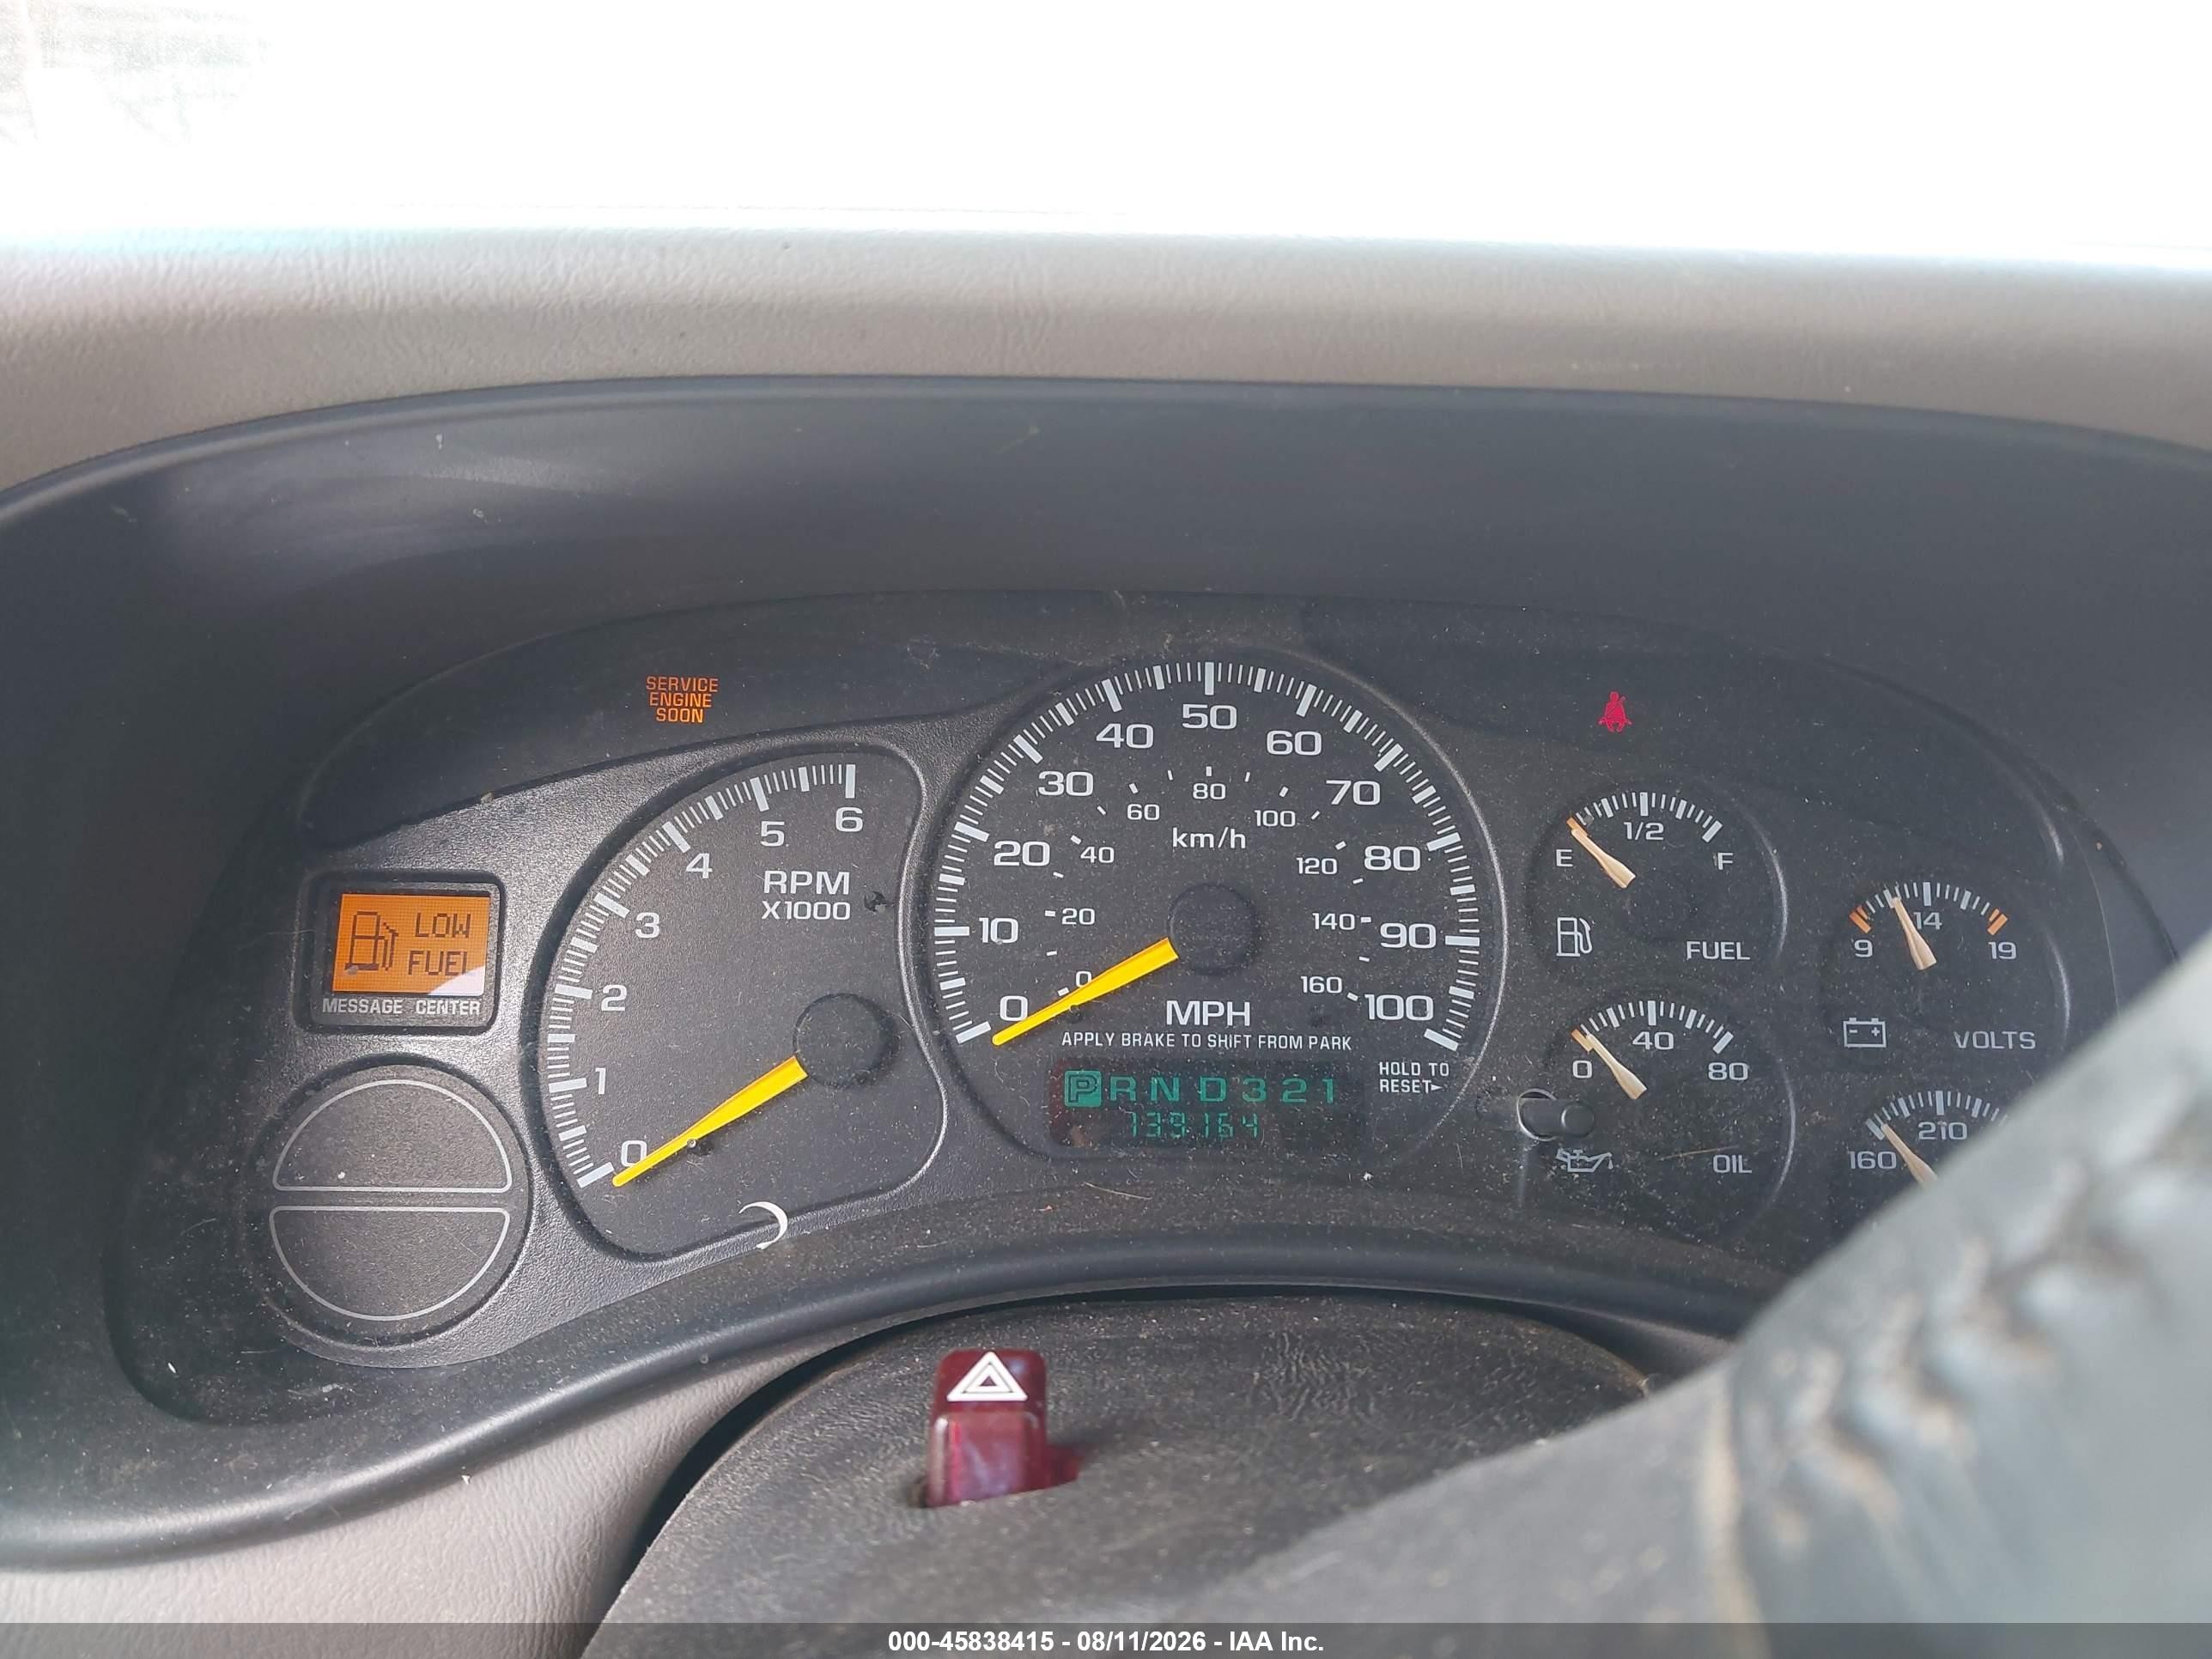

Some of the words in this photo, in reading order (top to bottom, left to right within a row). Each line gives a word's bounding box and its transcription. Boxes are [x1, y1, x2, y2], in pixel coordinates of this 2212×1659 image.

[647, 677, 718, 693] SERVICE
[649, 692, 713, 708] ENGINE
[656, 708, 703, 723] SOON
[1182, 704, 1237, 729] 50
[1097, 724, 1154, 748] 40
[1267, 732, 1322, 757] 60
[1037, 772, 1093, 797] 30
[1192, 783, 1225, 799] 80
[1326, 781, 1380, 805] 70
[835, 807, 863, 832] 6
[1127, 805, 1160, 821] 60
[1254, 811, 1297, 828] 100
[761, 821, 785, 848] 5
[1172, 829, 1247, 849] km/h
[1624, 822, 1665, 841] 1/2
[994, 842, 1051, 866] 20
[1080, 847, 1115, 864] 40
[1364, 847, 1420, 872] 80
[1557, 850, 1572, 868] E
[1717, 853, 1733, 871] F
[687, 854, 712, 878] 4
[1297, 858, 1338, 875] 120
[763, 871, 850, 895] RPM
[762, 901, 851, 921] X1000
[1061, 908, 1095, 925] 20
[416, 912, 471, 938] LOW
[635, 913, 660, 939] 3
[1312, 913, 1355, 931] 140
[1914, 912, 1942, 930] 14
[979, 918, 1018, 944] 10
[1379, 923, 1436, 948] 90
[1686, 941, 1750, 960] FUEL
[1855, 939, 1873, 957] 9
[1988, 941, 2017, 959] 19
[1075, 970, 1092, 988] 0
[1301, 976, 1342, 994] 160
[323, 999, 404, 1013] MESSAGE
[416, 1000, 480, 1015] CENTER
[602, 984, 627, 1012] 2
[1367, 995, 1434, 1020] 100
[999, 996, 1028, 1022] 0
[1166, 1001, 1250, 1025] MPH
[1062, 1032, 1114, 1046] APPLY
[1121, 1033, 1176, 1048] BRAKE
[1181, 1033, 1201, 1048] TO
[1206, 1034, 1252, 1048] SHIFT
[1258, 1035, 1304, 1049] FROM
[1309, 1036, 1352, 1051] PARK
[1632, 1032, 1674, 1050] 40
[1954, 1031, 2036, 1049] VOLTS
[1379, 1061, 1420, 1077] HOLD
[1429, 1062, 1449, 1077] TO
[1571, 1060, 1593, 1079] 0
[1708, 1062, 1748, 1081] 80
[595, 1067, 605, 1094] 1
[1110, 1077, 1136, 1101] R
[1151, 1077, 1180, 1102] N
[1201, 1077, 1225, 1103] D
[1243, 1078, 1267, 1103] 3
[1282, 1078, 1307, 1103] 2
[1322, 1079, 1334, 1103] 1
[1379, 1079, 1431, 1094] RESET
[1128, 1112, 1259, 1139] 139164
[1917, 1122, 1968, 1141] 210
[621, 1139, 647, 1167] 0
[1850, 1152, 1897, 1170] 160
[1713, 1155, 1752, 1174] OIL
